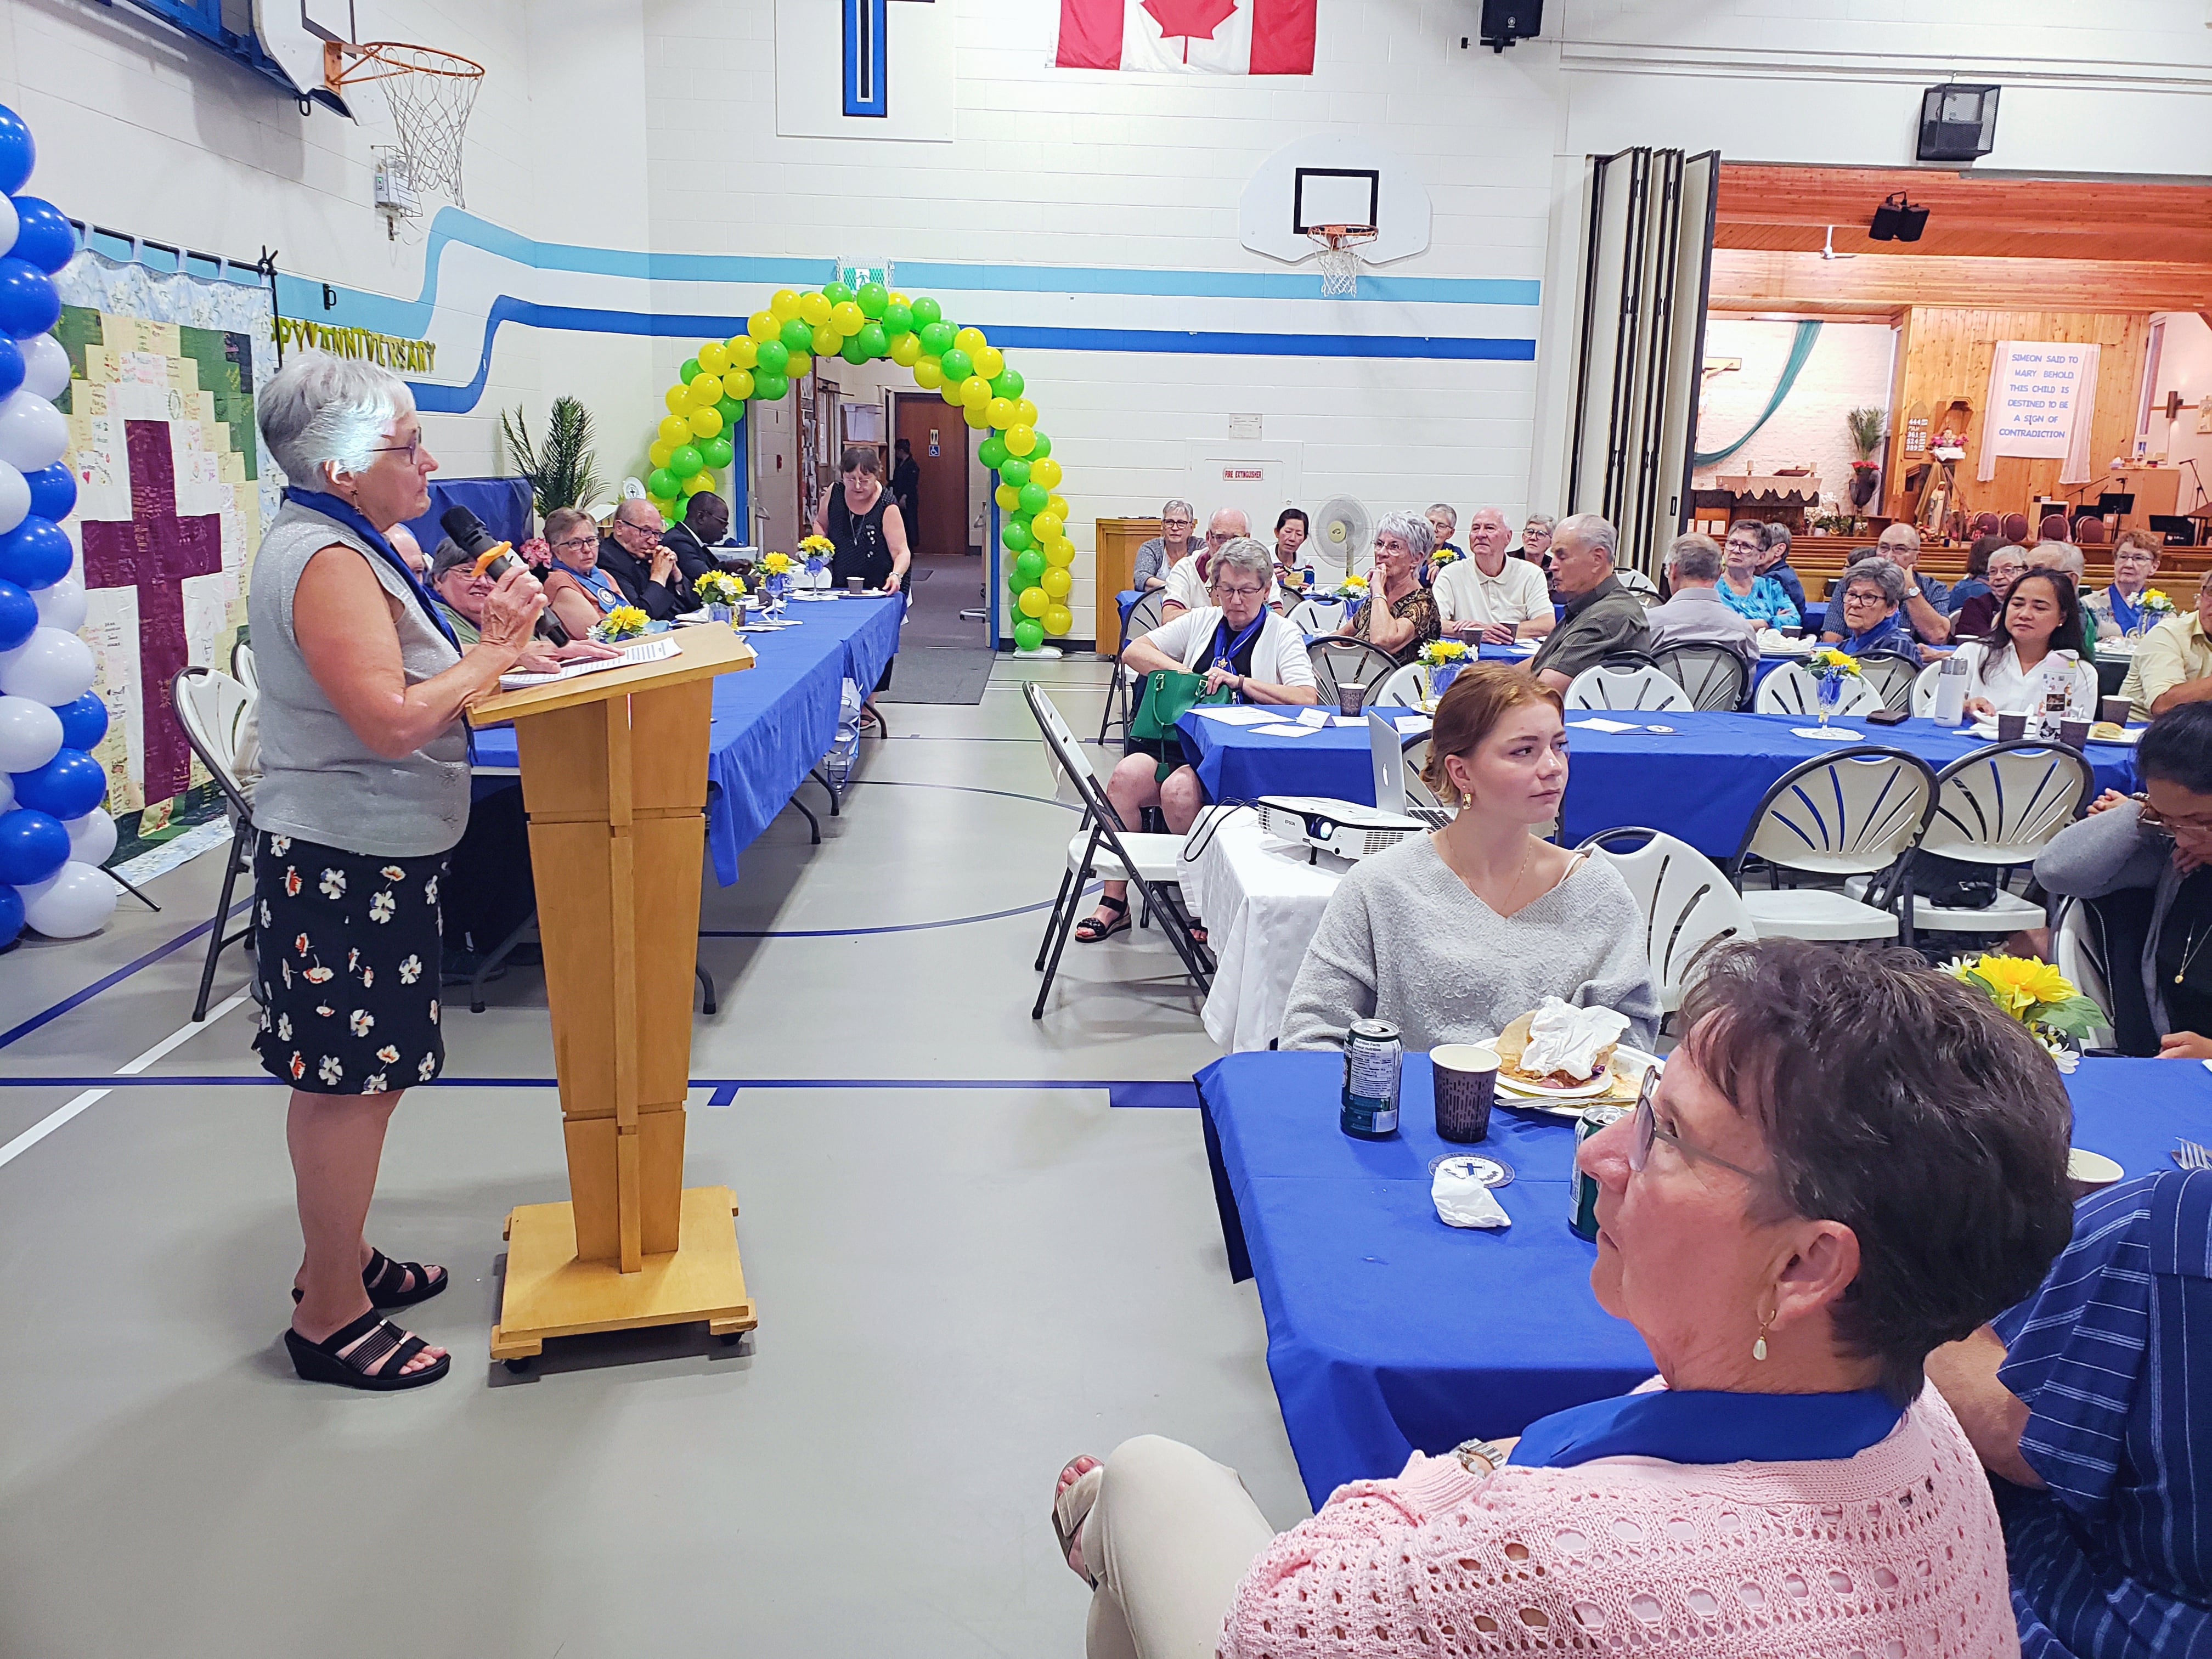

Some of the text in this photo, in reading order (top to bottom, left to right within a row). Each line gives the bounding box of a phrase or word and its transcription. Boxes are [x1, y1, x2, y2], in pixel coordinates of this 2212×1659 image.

[2012, 354, 2042, 362] SIMEON
[2046, 355, 2066, 363] SAID
[2010, 384, 2028, 392] THIS
[2032, 385, 2056, 393] CHILD
[2007, 399, 2045, 408] DESTINED
[2024, 415, 2044, 423] SIGN
[1999, 428, 2065, 438] CONTRADICTION
